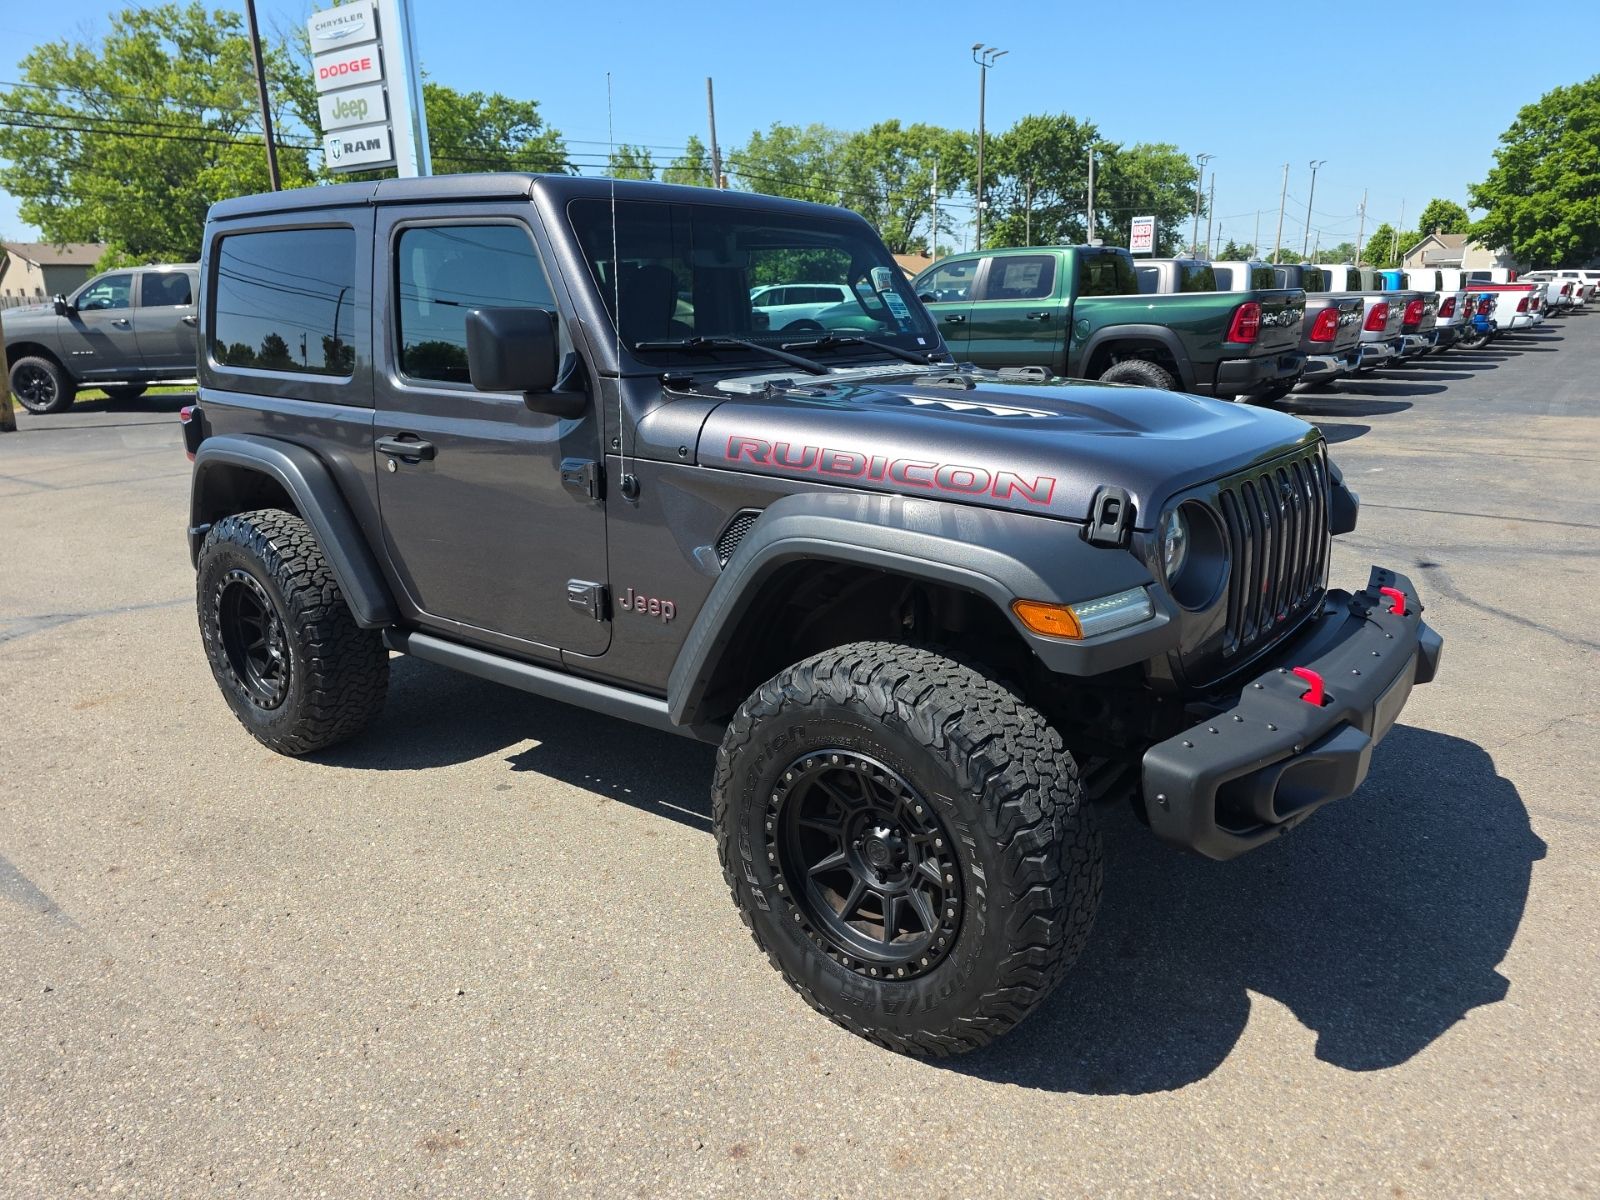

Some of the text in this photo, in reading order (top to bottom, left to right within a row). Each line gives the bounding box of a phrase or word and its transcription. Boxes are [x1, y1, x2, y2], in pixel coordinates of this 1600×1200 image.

[315, 13, 363, 31] CHRYSLER
[320, 58, 371, 79] DODGE
[332, 97, 368, 120] Jeep
[344, 138, 381, 154] RAM
[1133, 224, 1151, 237] USED
[1132, 236, 1150, 247] CARS
[724, 435, 1057, 506] RUBICON
[619, 588, 676, 623] Jeep
